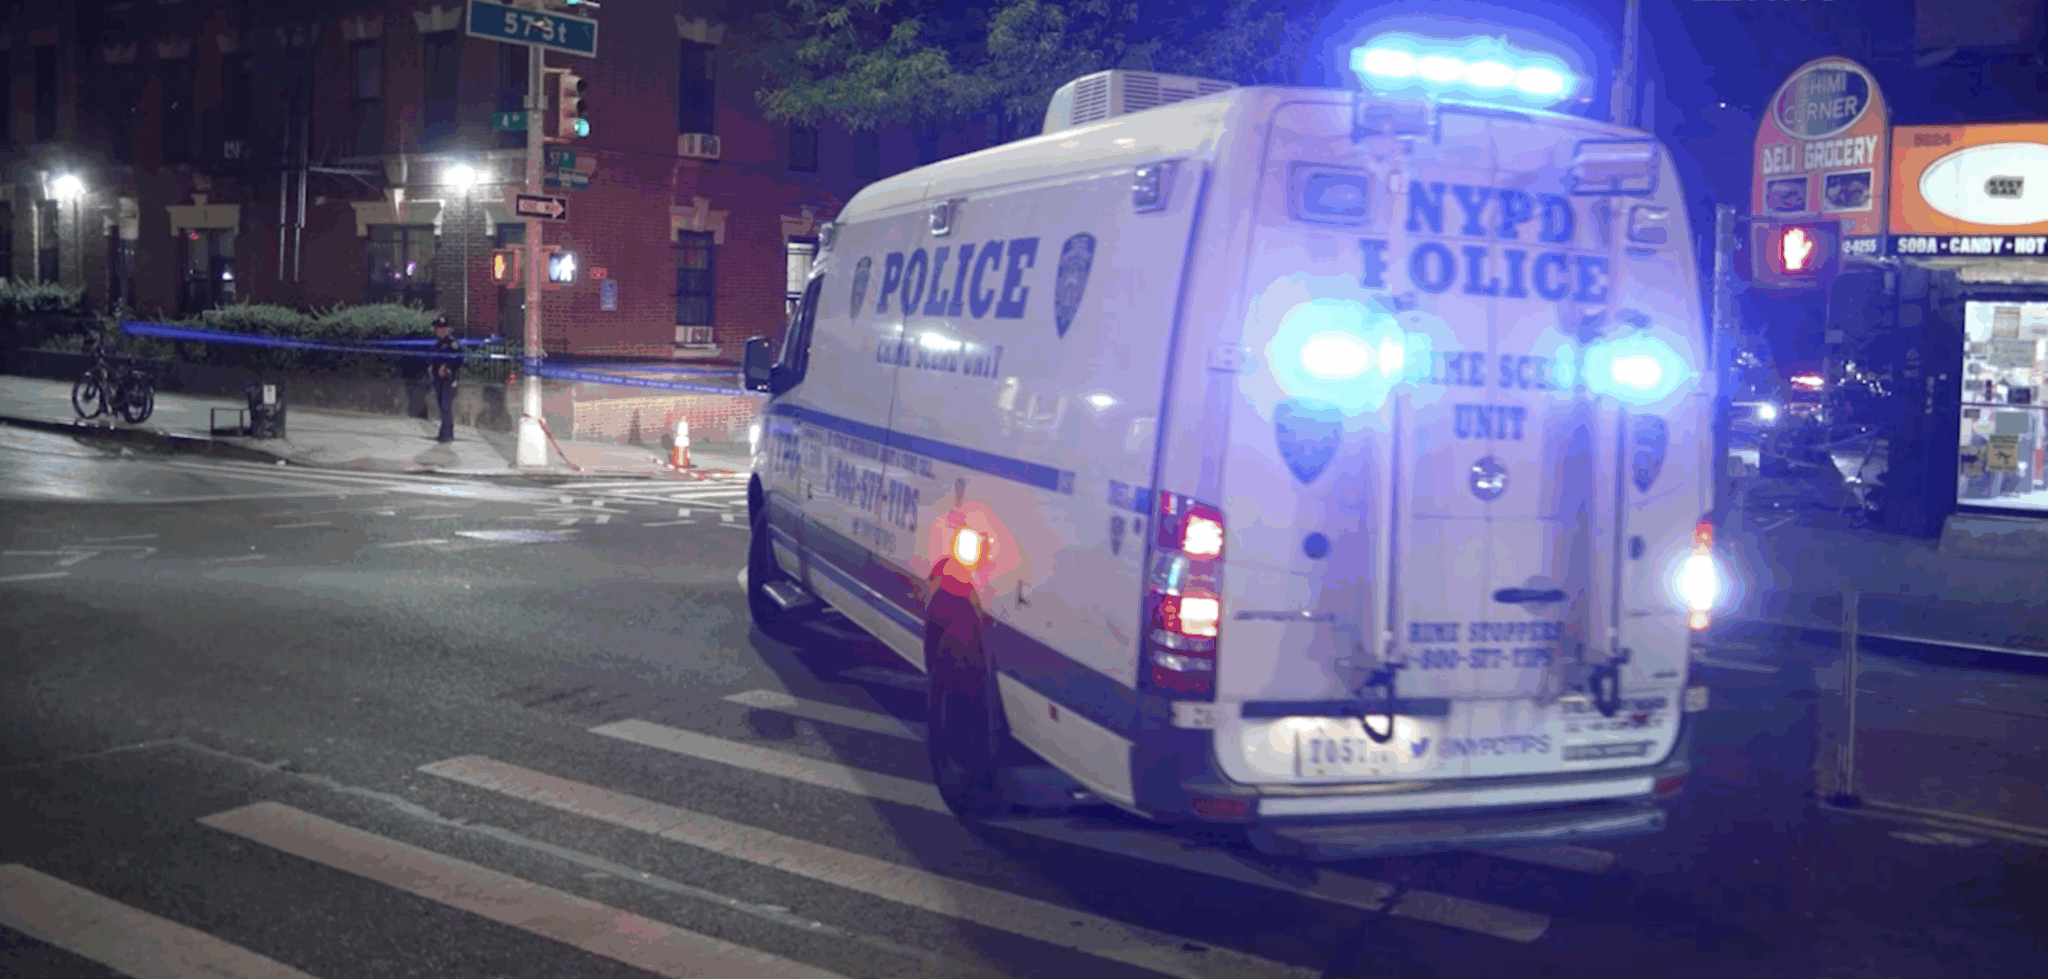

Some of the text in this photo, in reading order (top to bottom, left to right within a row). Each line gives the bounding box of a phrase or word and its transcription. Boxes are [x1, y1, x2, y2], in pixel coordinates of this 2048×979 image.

[504, 12, 567, 43] 57 St
[1763, 134, 1878, 175] DELI GROCERY
[1404, 180, 1577, 244] NYPD
[1897, 236, 2047, 254] SODA CANDY HOT
[876, 236, 1040, 320] POLICE
[1453, 403, 1528, 441] UNIT
[1407, 620, 1459, 643] RIME
